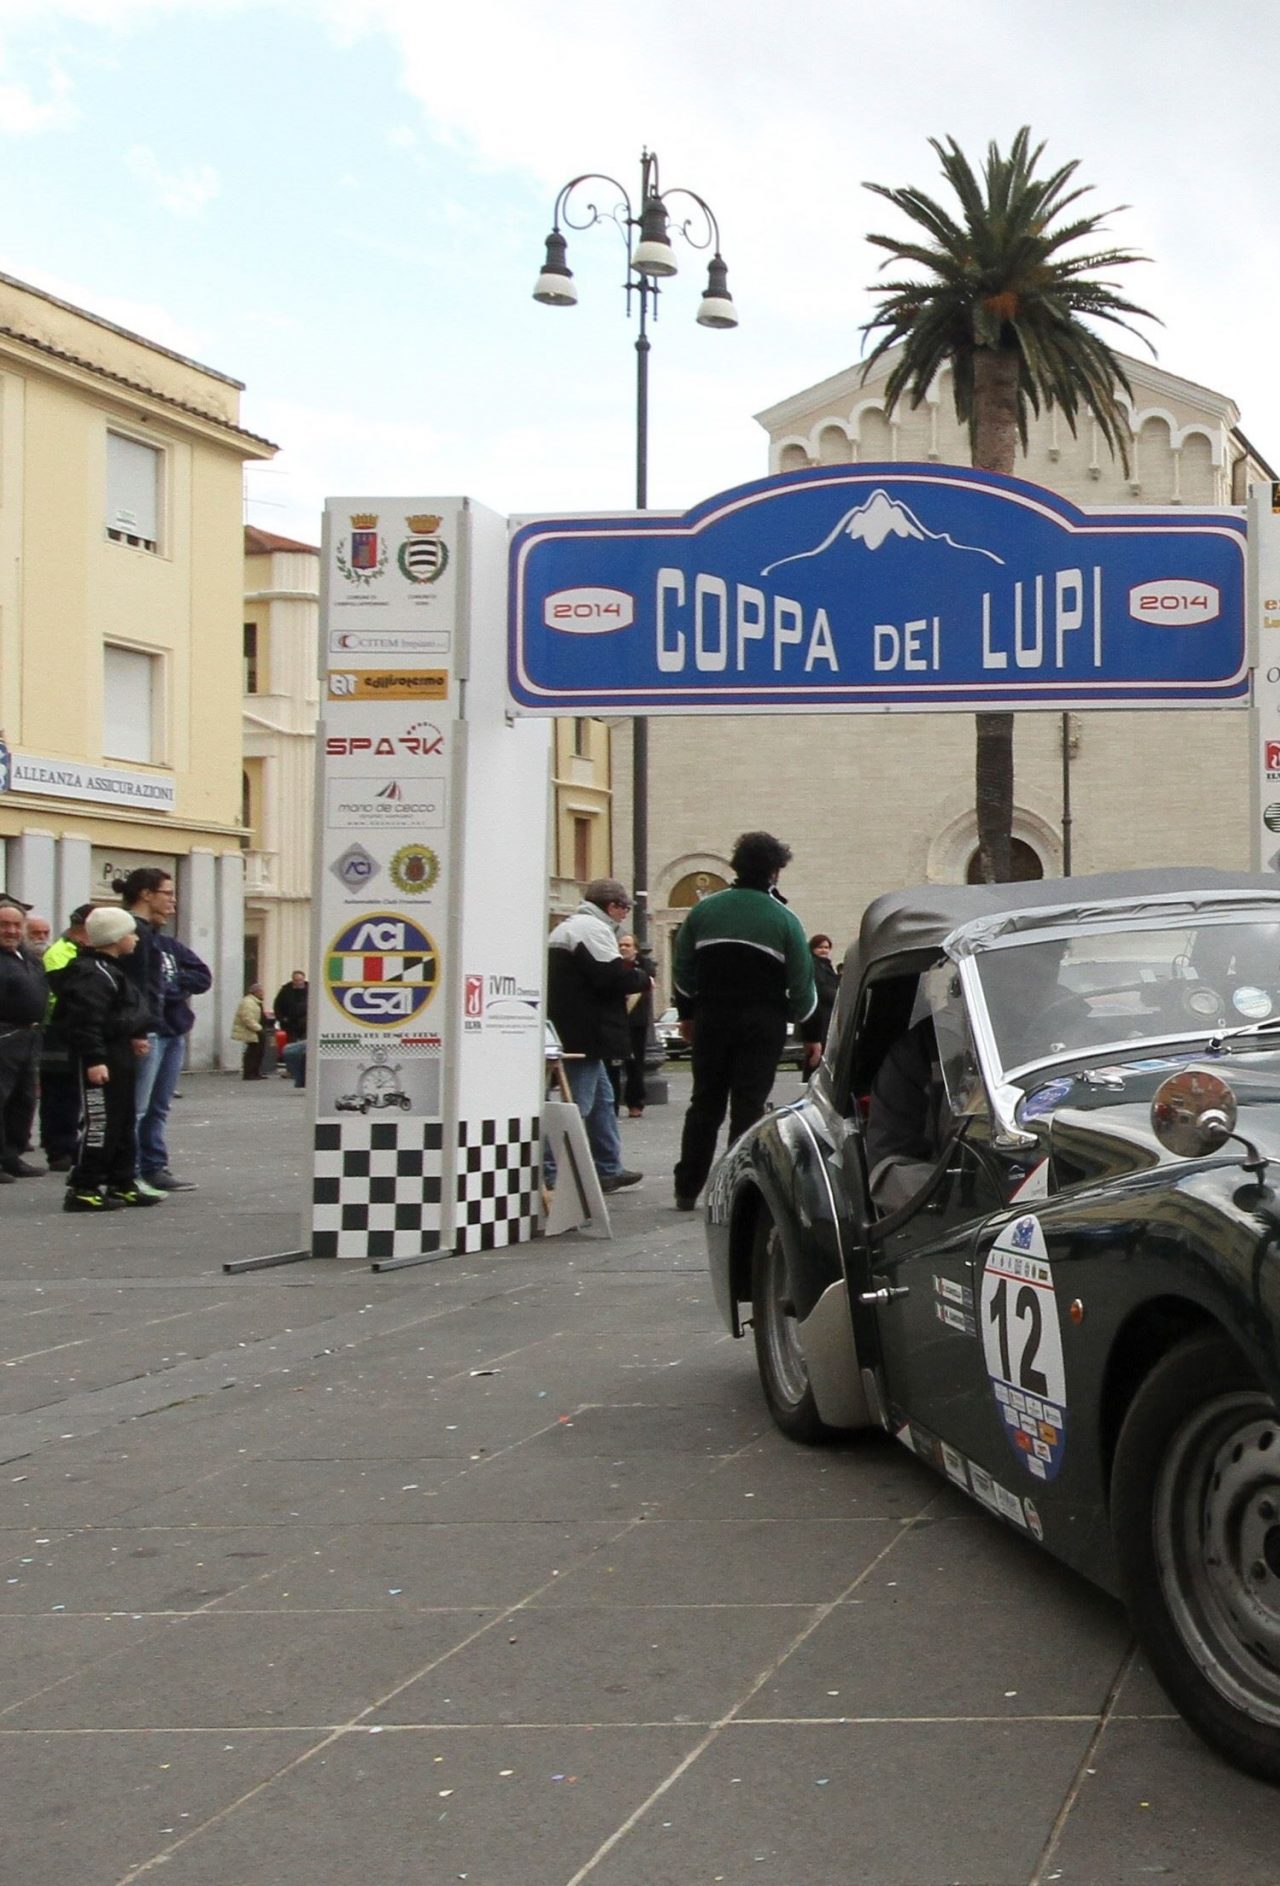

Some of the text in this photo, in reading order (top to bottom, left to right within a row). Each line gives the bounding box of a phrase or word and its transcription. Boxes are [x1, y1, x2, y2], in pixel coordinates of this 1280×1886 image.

[553, 603, 621, 618] 2014
[1139, 595, 1209, 610] 2014
[656, 565, 1102, 673] COPPA DEI LUPI
[360, 639, 398, 648] CITEM
[326, 737, 444, 756] SPARK
[13, 765, 174, 802] ALLEANZA ASSICURAZIONI
[375, 803, 392, 813] de
[346, 861, 372, 875] ACI
[350, 922, 406, 951] ACI
[343, 986, 414, 1015] CSAI
[989, 1278, 1050, 1400] 12
